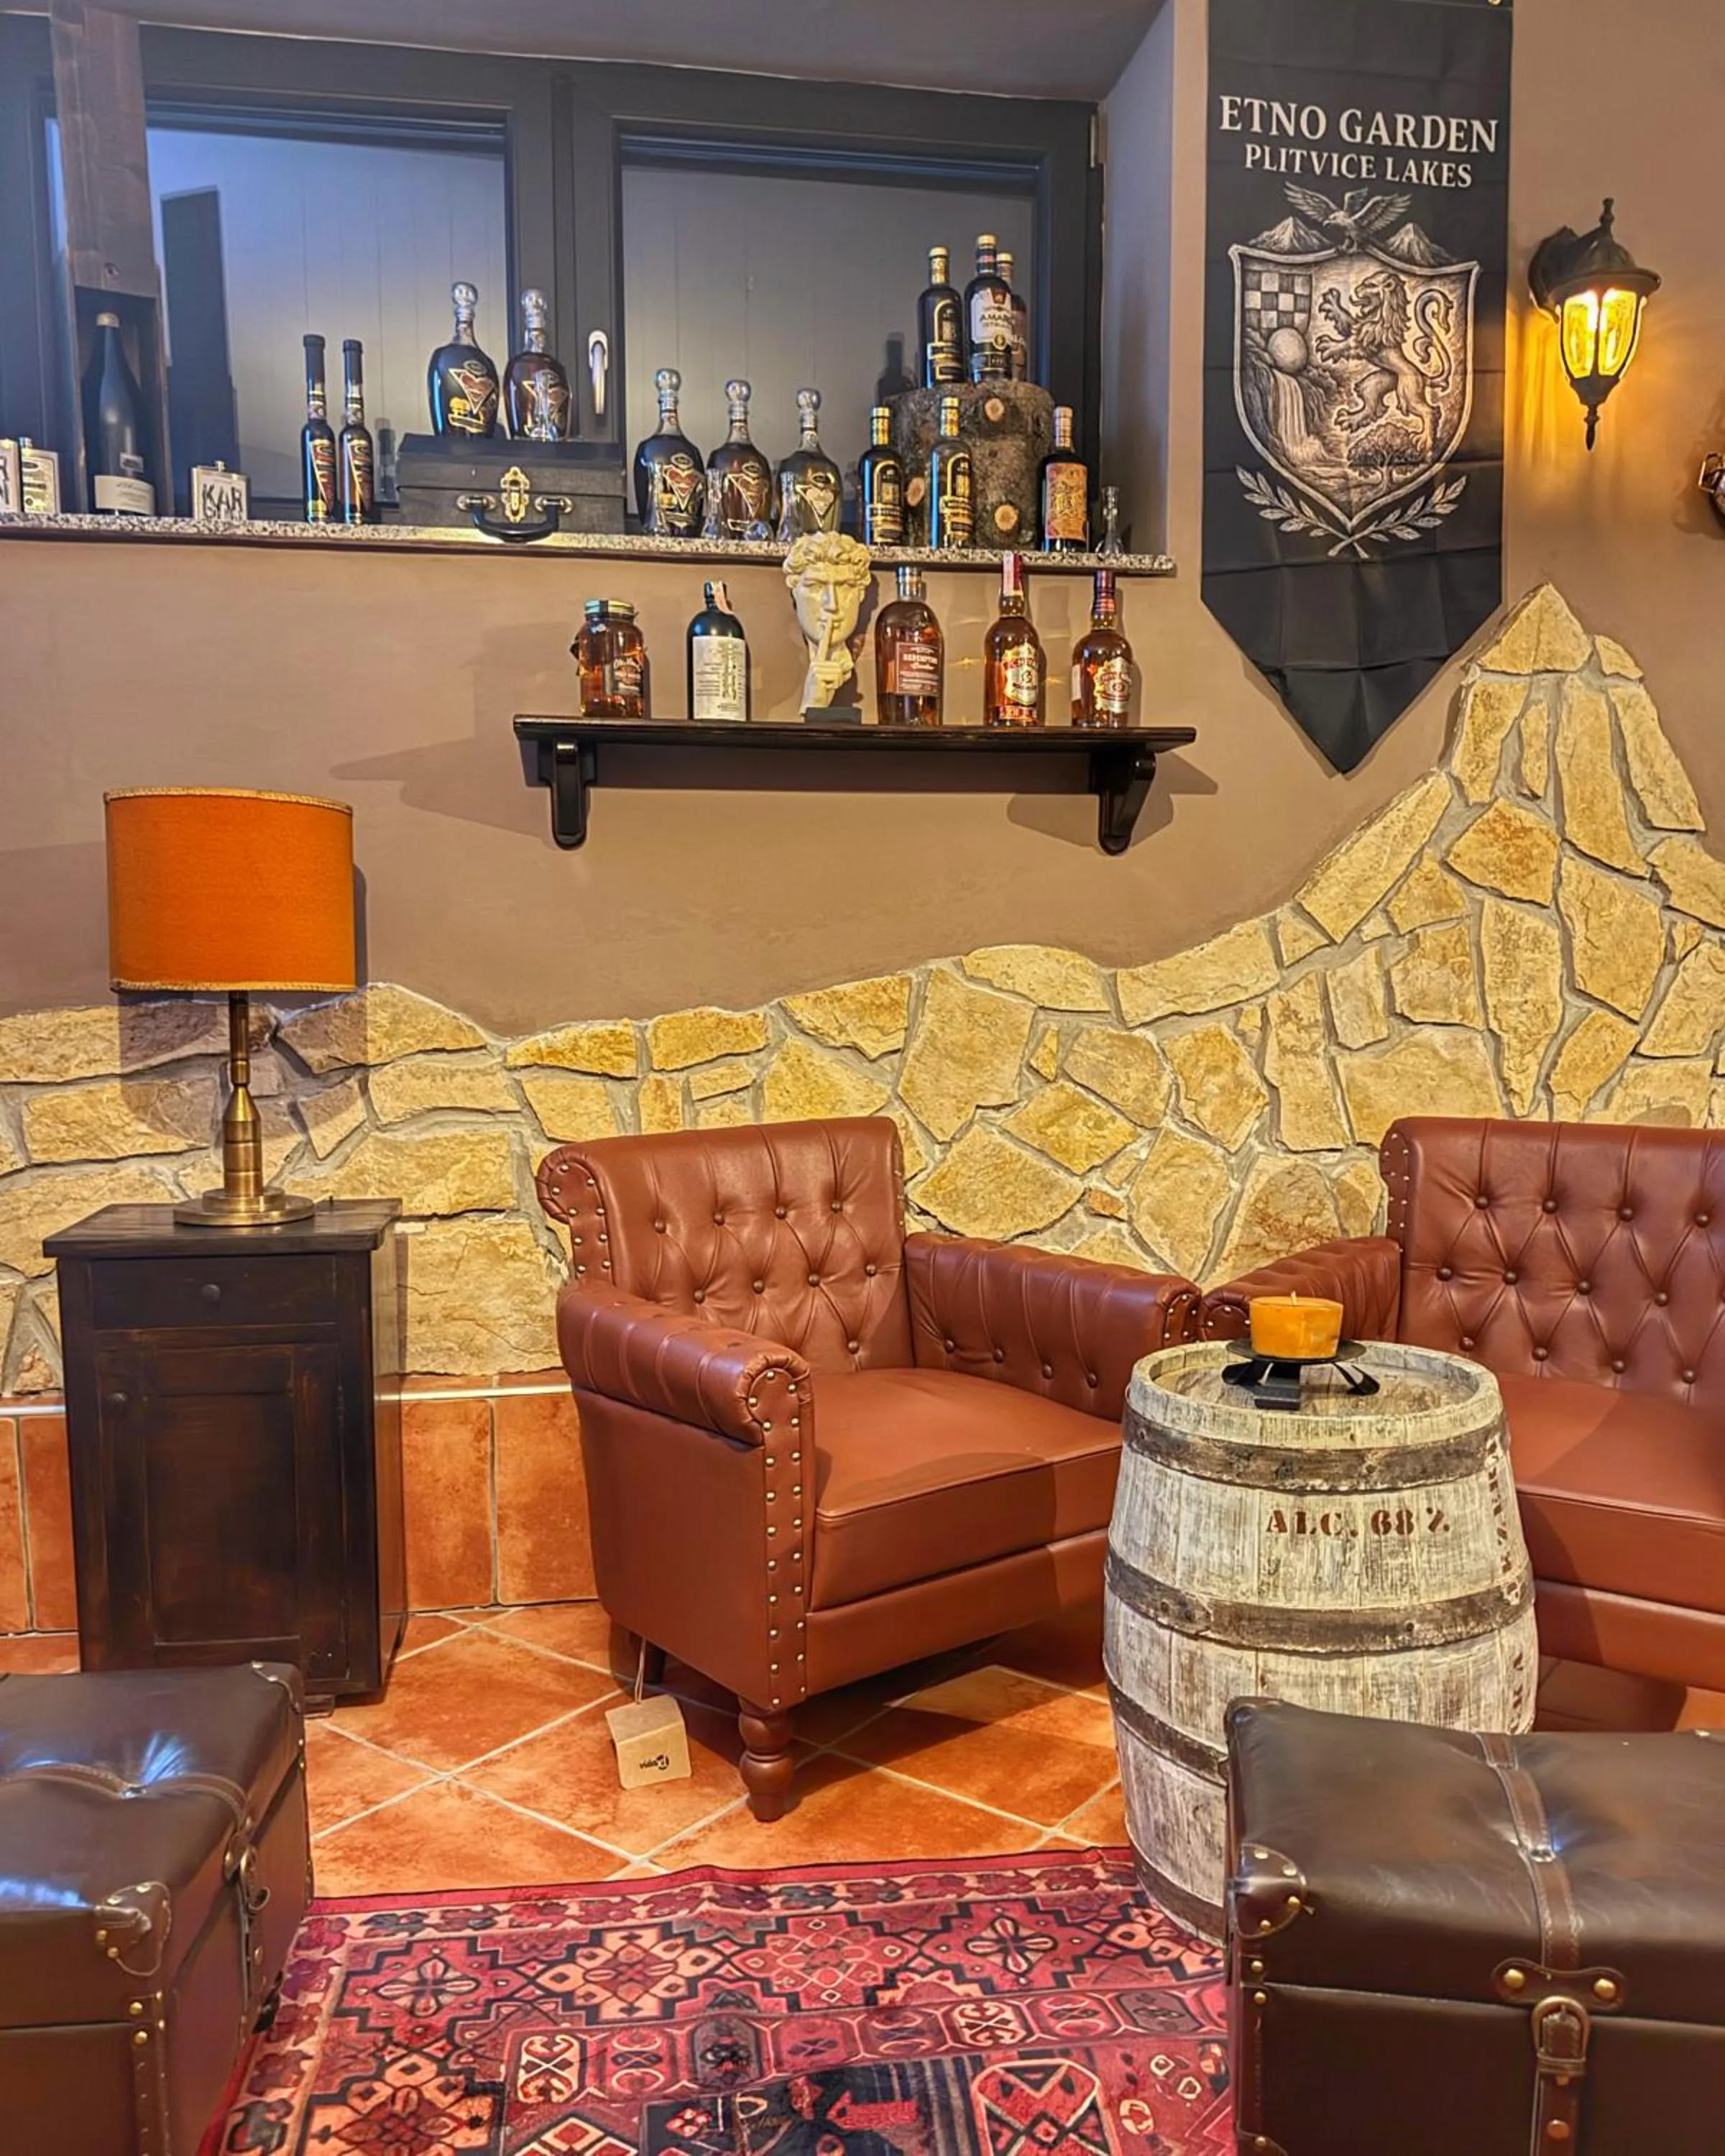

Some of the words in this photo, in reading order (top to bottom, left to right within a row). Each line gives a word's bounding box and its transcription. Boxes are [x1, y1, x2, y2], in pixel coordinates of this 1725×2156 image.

[1220, 96, 1327, 140] ETNO
[1339, 109, 1498, 153] GARDEN
[1245, 144, 1376, 179] PLITVICE
[1386, 157, 1472, 188] LAKES
[1265, 1509, 1358, 1538] ALC.
[1370, 1508, 1414, 1536] 68
